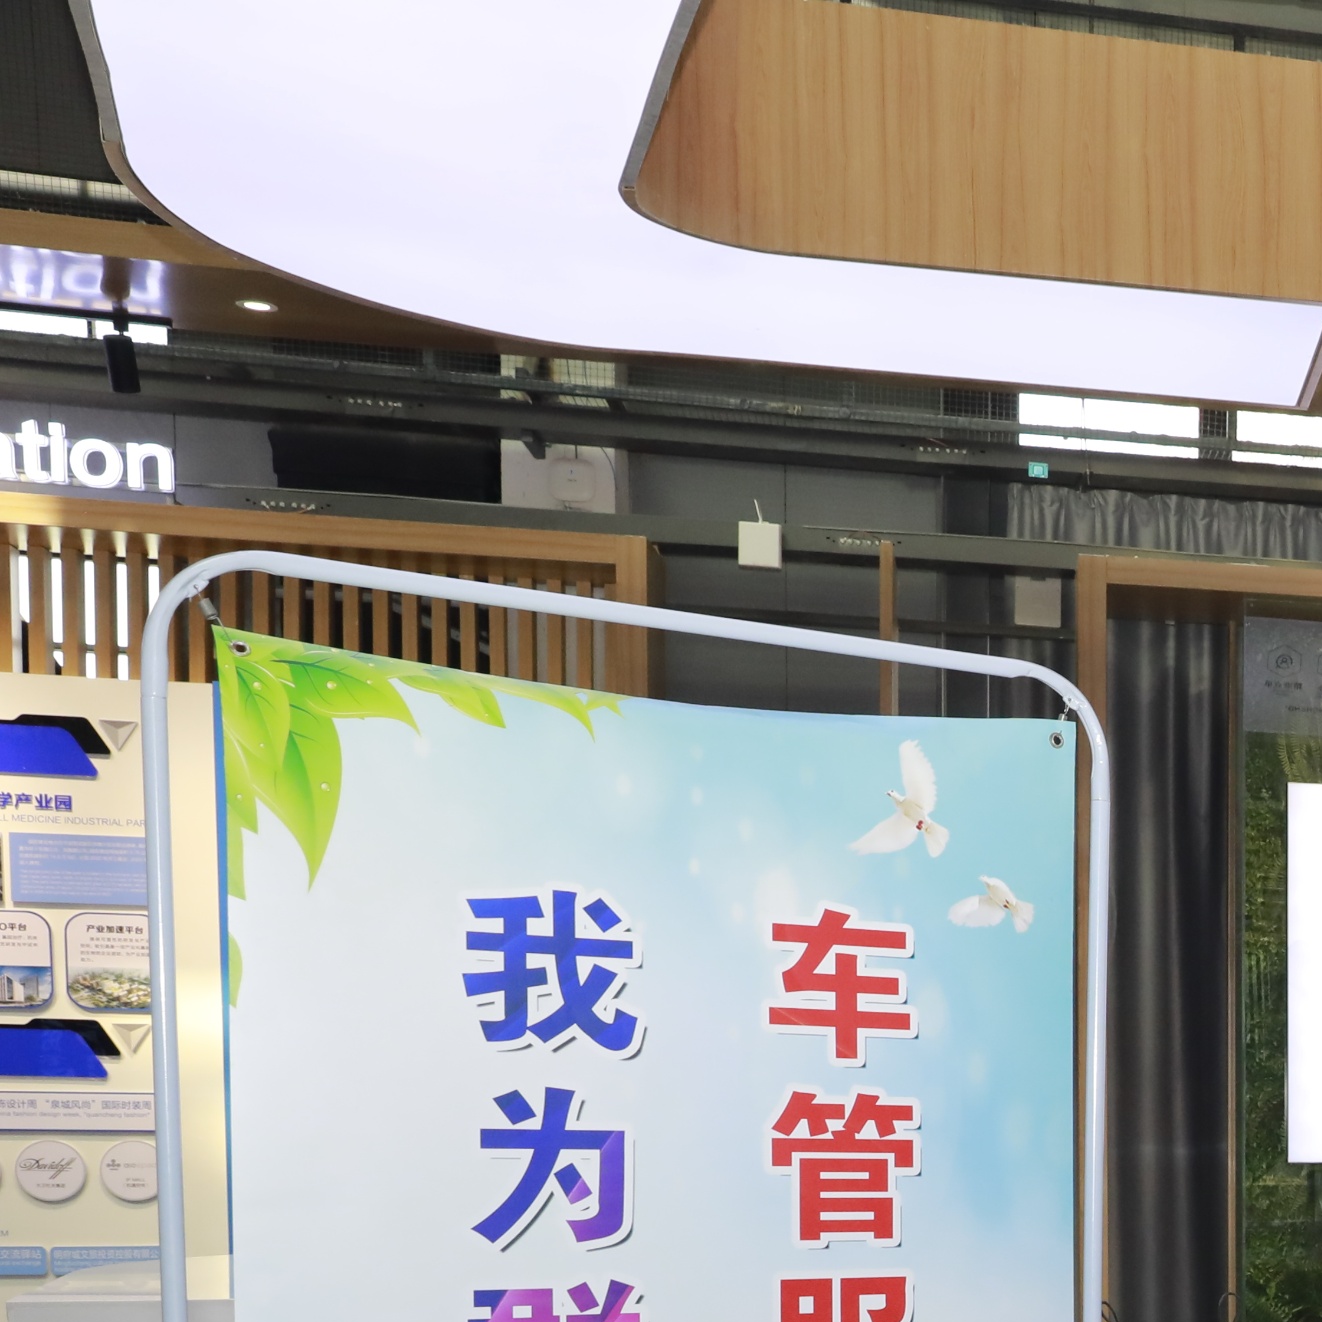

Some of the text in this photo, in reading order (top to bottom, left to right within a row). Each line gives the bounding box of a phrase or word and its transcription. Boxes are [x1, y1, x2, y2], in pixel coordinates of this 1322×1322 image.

[0, 792, 72, 812] 学产业园
[11, 814, 62, 824] MEDICINE
[63, 816, 124, 827] INDUSTRIAL
[86, 924, 144, 934] 产业加速平台
[101, 1101, 151, 1111] 国际时装周
